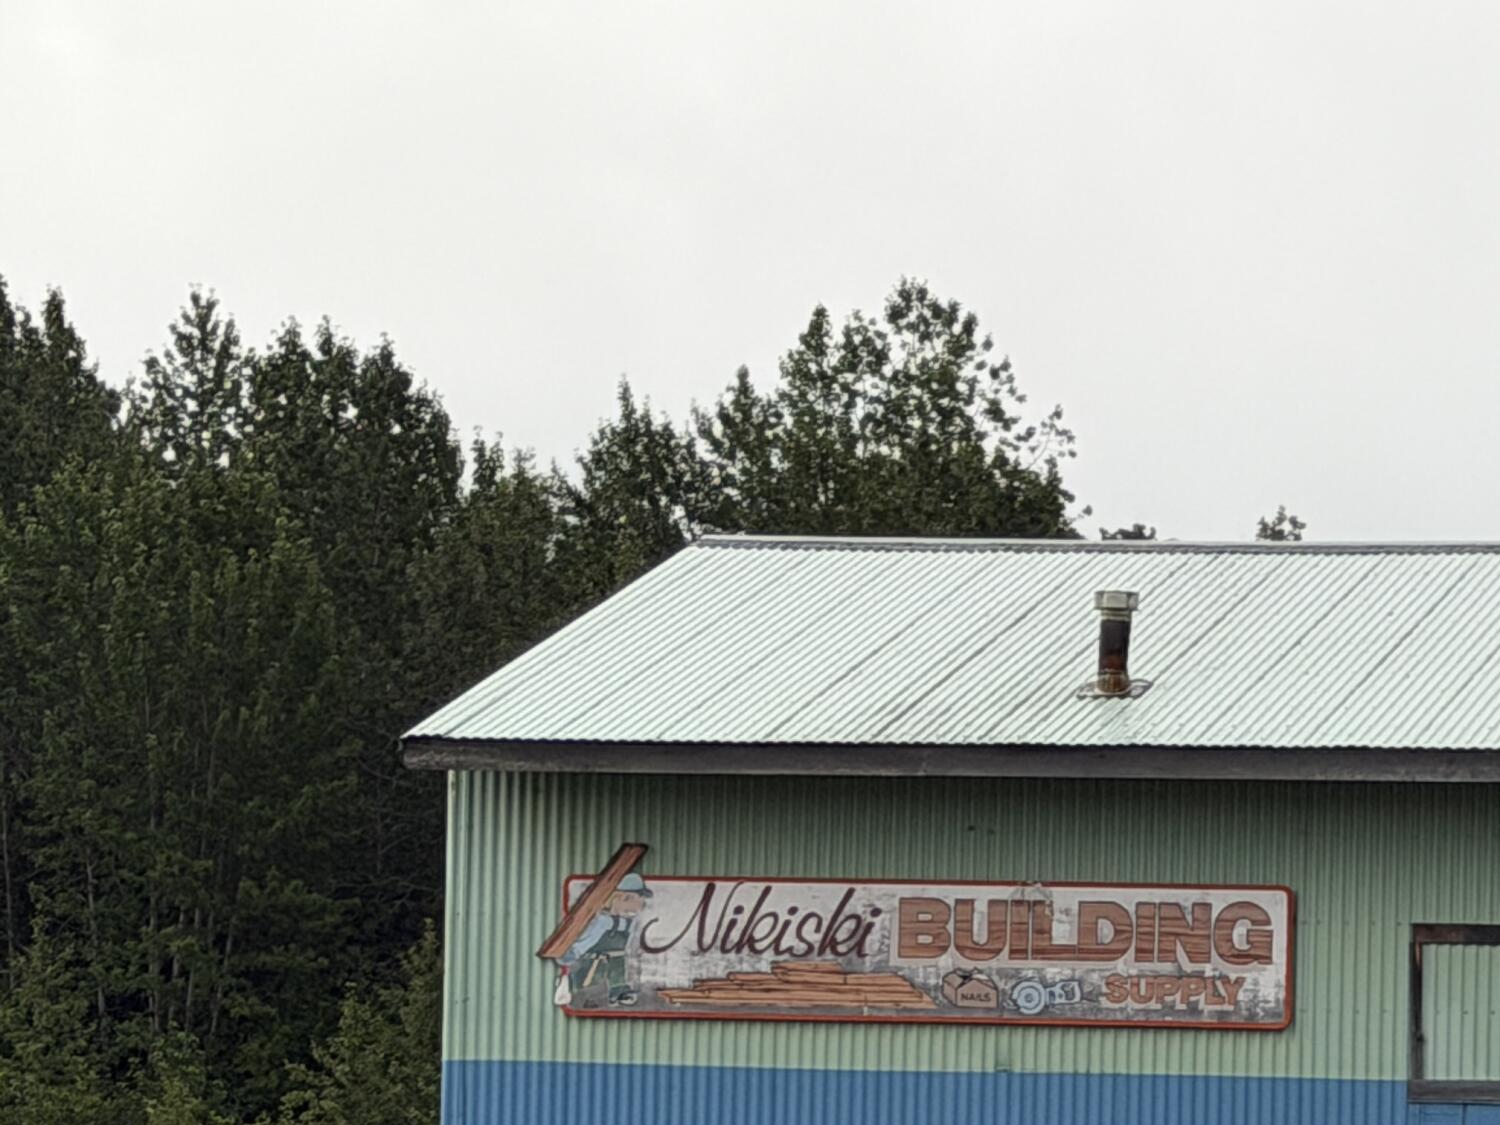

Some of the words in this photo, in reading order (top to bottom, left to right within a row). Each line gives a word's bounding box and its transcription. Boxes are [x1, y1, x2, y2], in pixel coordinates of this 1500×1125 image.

[639, 881, 883, 958] Nikiski
[897, 896, 1274, 966] BUILDING
[1102, 973, 1246, 1007] SUPPLY
